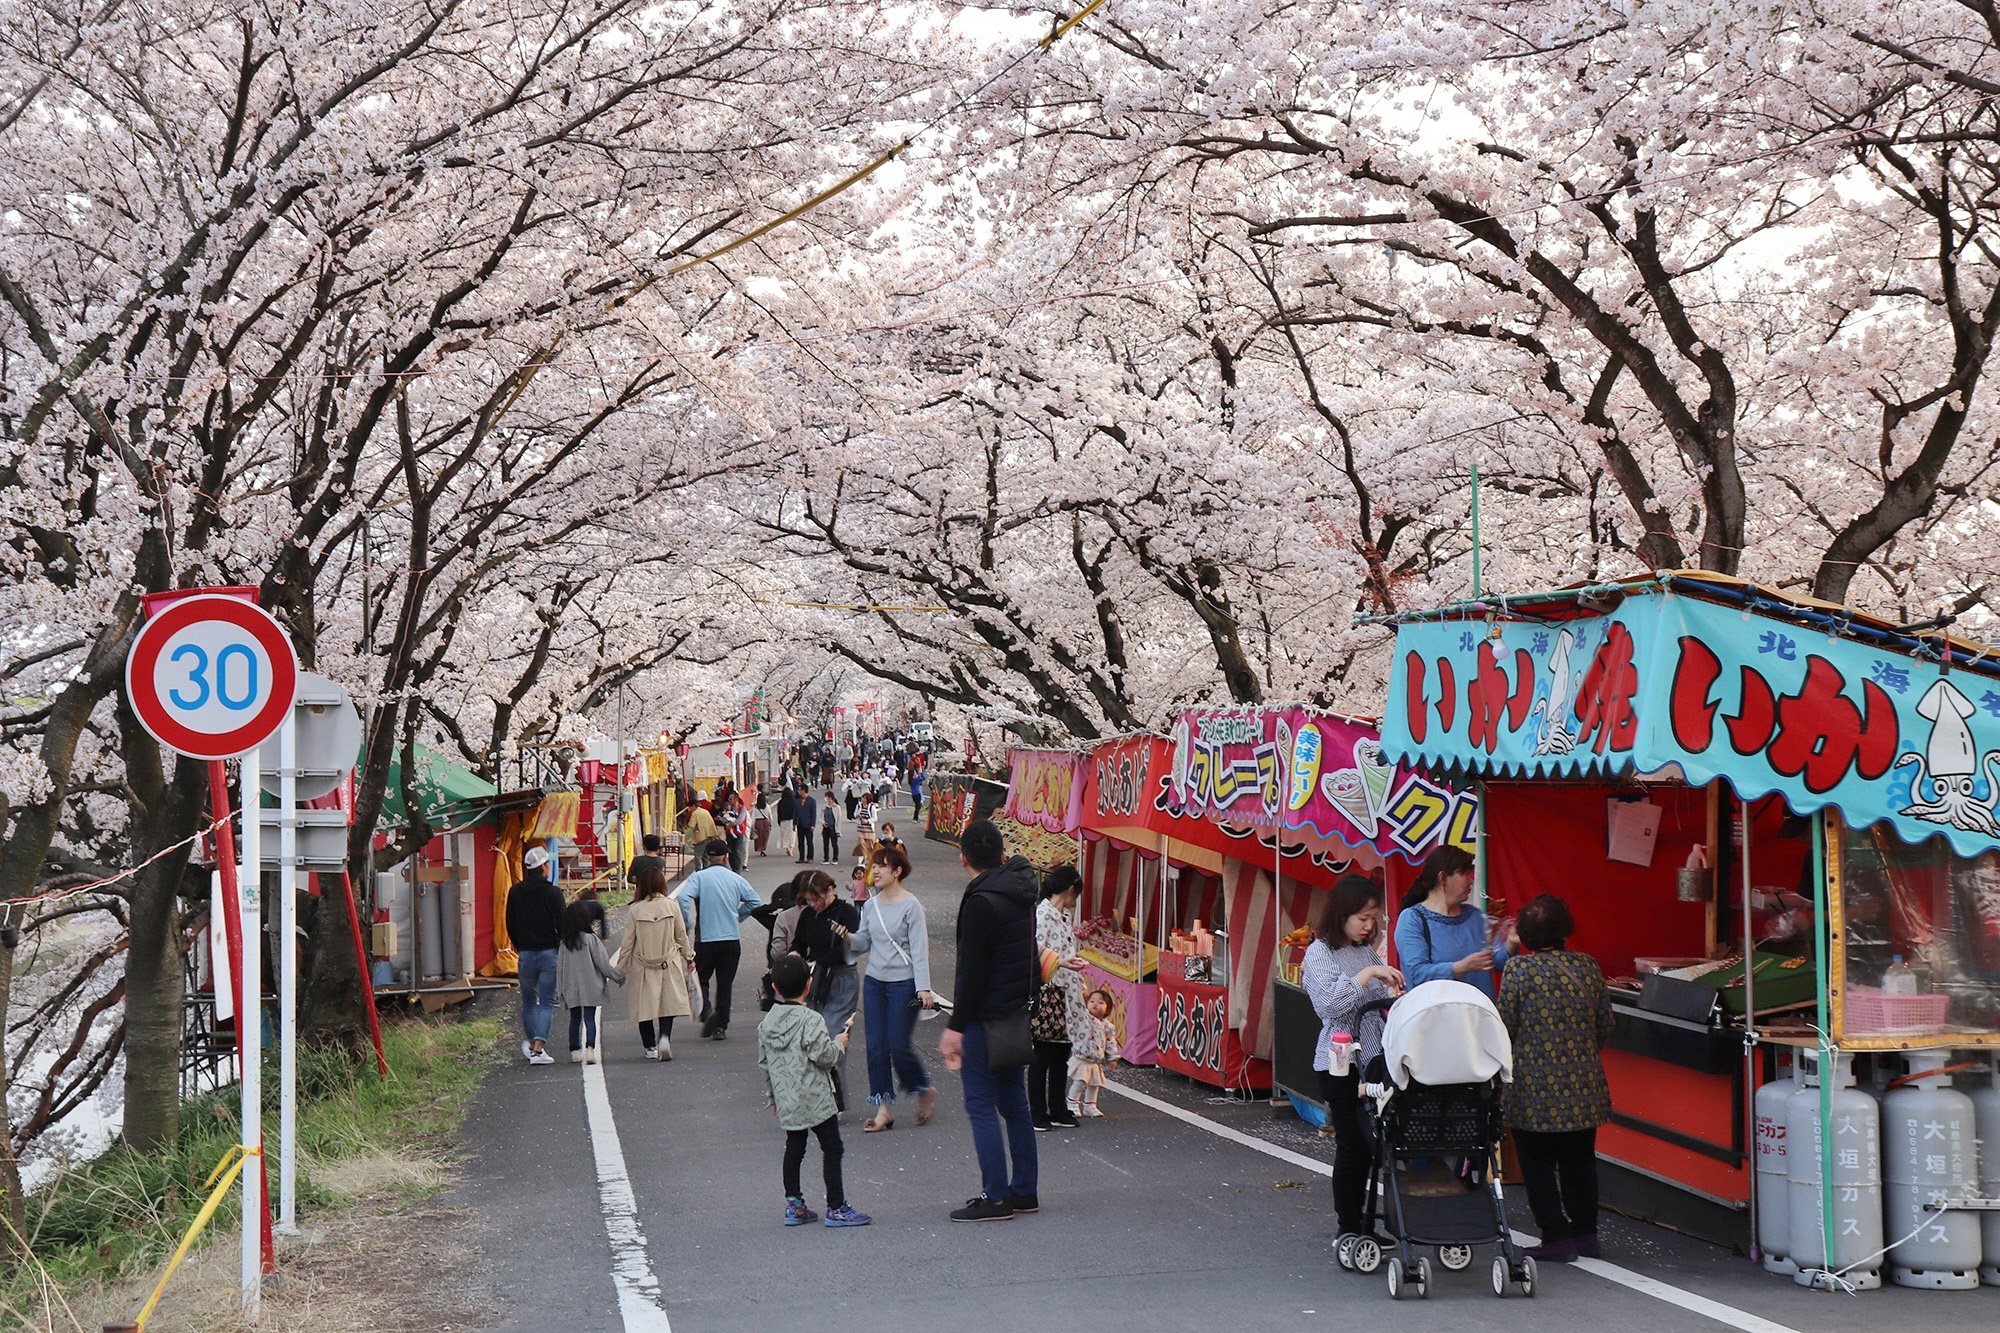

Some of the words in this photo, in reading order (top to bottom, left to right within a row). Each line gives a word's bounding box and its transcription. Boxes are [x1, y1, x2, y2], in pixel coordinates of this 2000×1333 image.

[169, 643, 258, 711] 30
[1669, 634, 1900, 794] いか
[1188, 741, 1281, 815] クレープ
[1157, 987, 1225, 1072] からあげ
[1838, 1115, 1861, 1236] 大垣ガス
